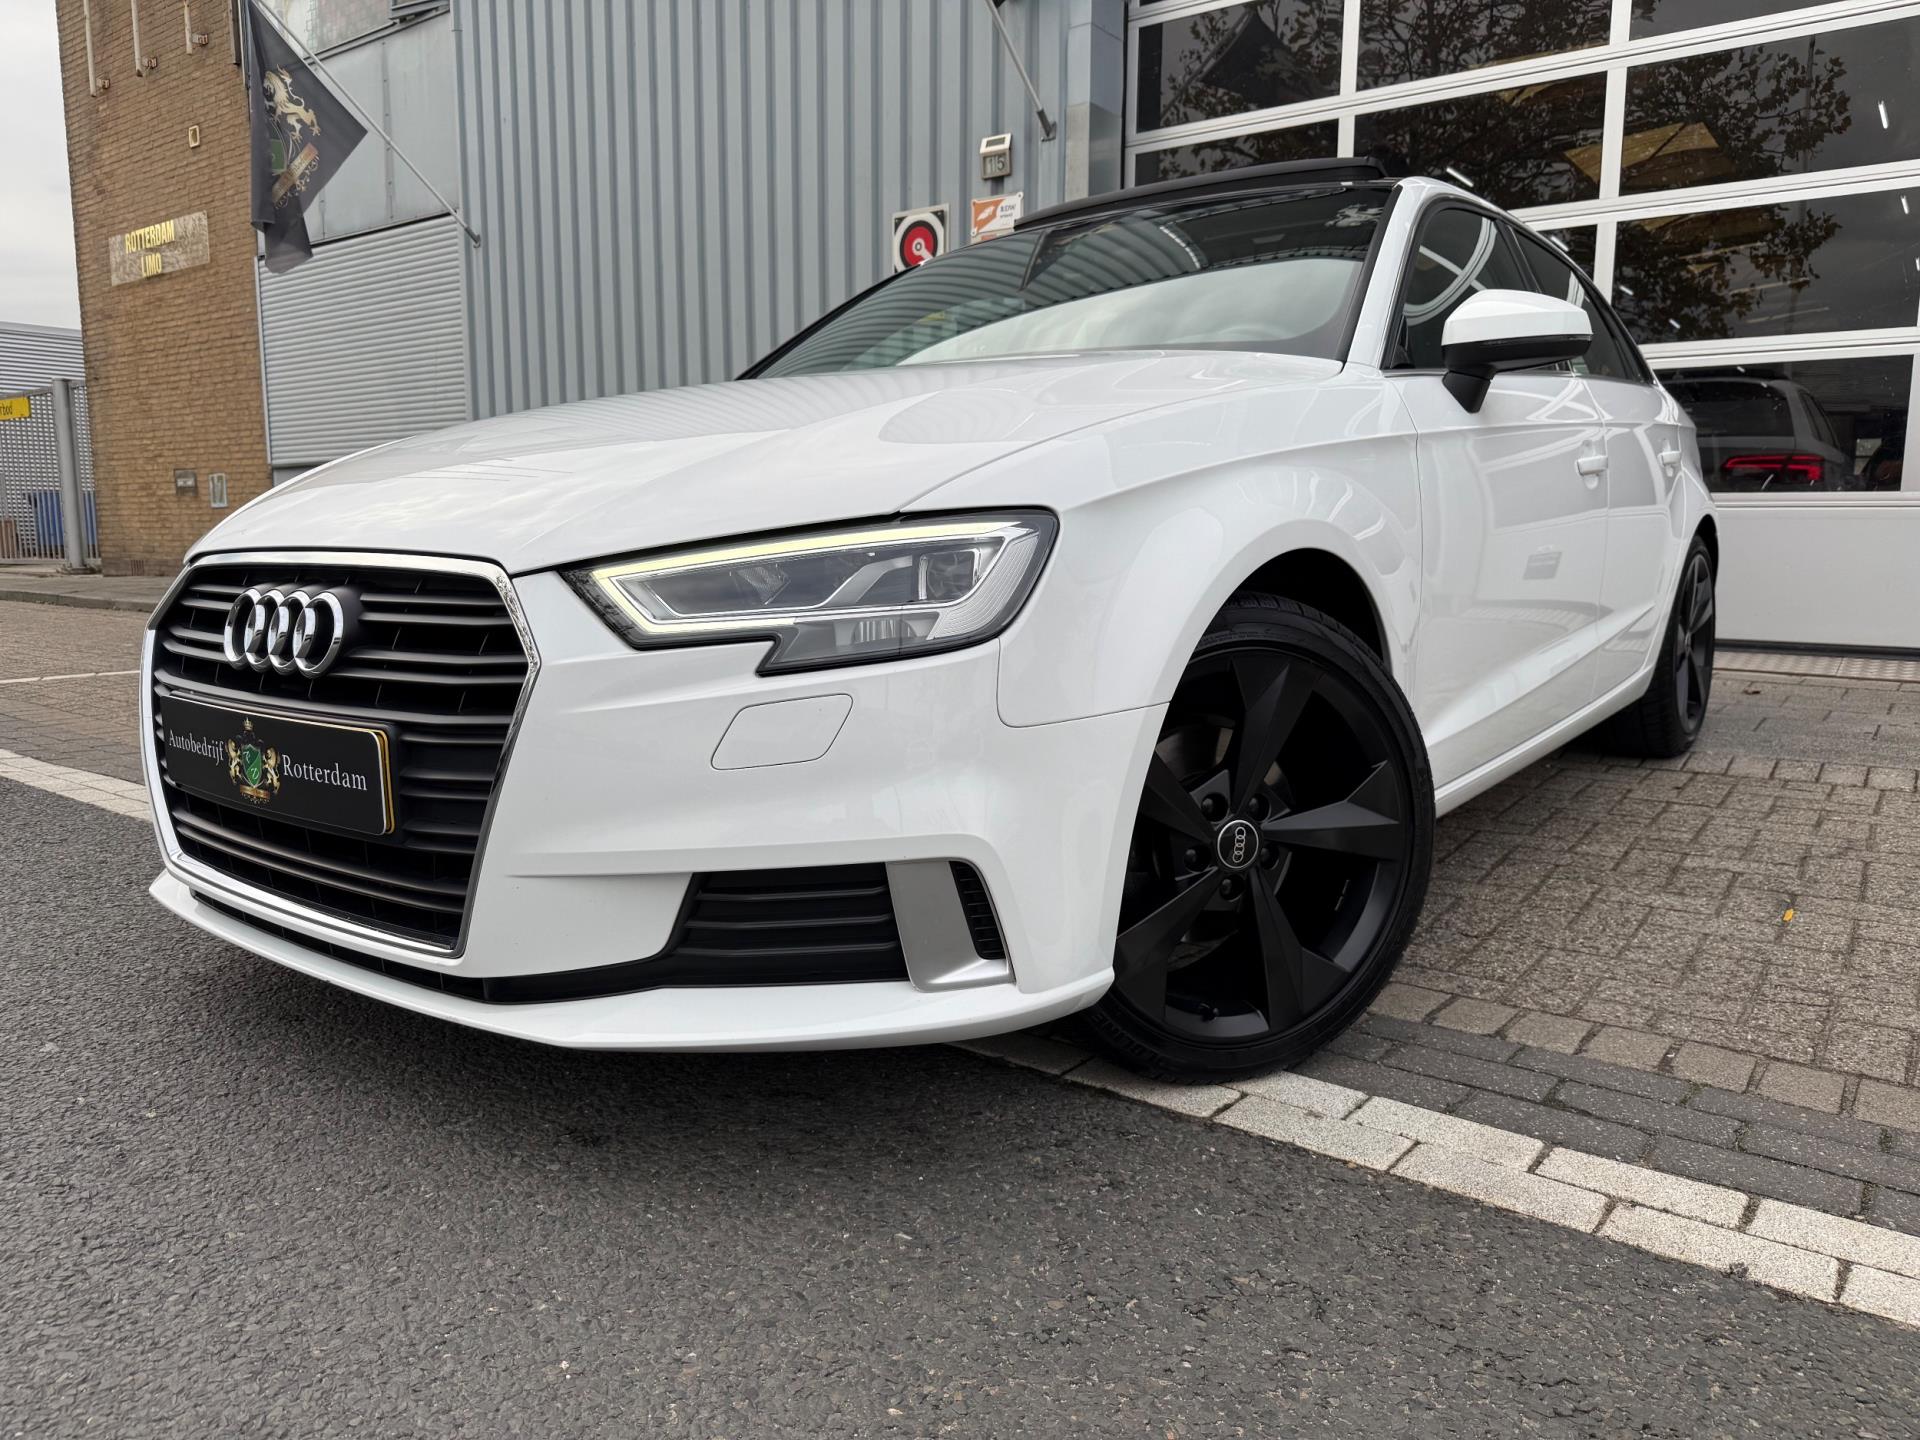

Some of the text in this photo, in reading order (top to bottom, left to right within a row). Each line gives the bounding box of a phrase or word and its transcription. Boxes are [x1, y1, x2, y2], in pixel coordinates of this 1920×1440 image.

[124, 219, 175, 254] ROTTERDAM
[141, 252, 162, 278] LIMO
[169, 729, 368, 791] Autobedrijf Rotterdam
